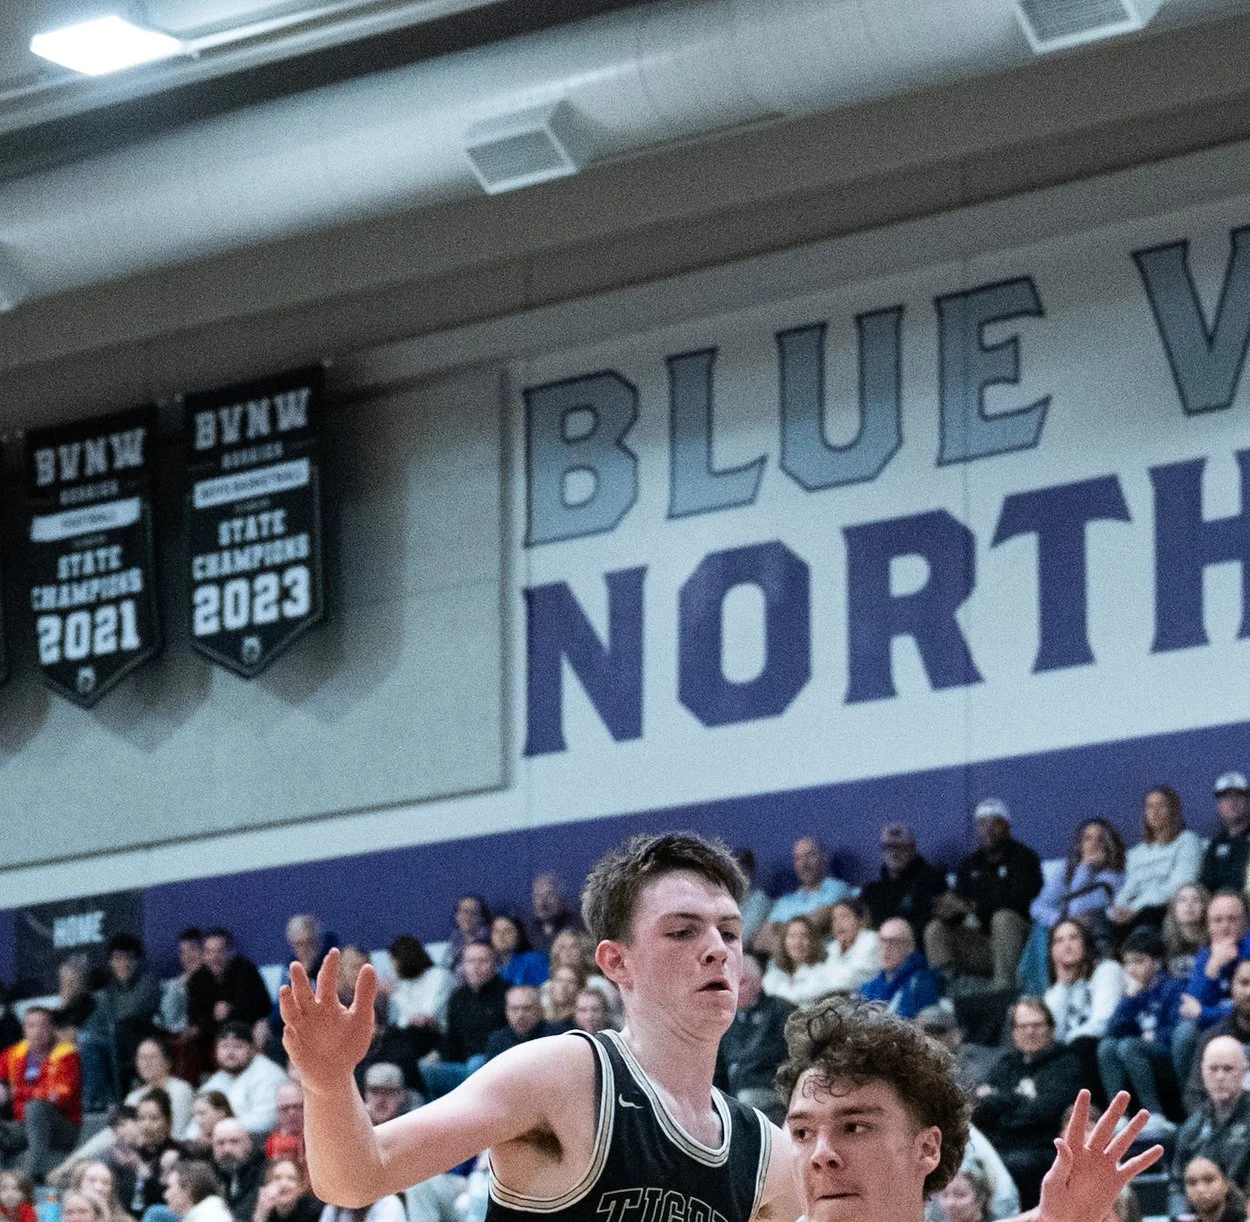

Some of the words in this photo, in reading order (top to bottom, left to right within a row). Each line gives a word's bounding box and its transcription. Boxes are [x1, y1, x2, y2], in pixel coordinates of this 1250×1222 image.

[194, 387, 311, 450] BVNW
[523, 276, 1052, 549] BLUE
[34, 426, 147, 487] BVNW
[218, 508, 286, 546] STATE
[57, 545, 122, 580] STATE
[37, 599, 141, 665] 2021
[193, 565, 310, 636] 2023
